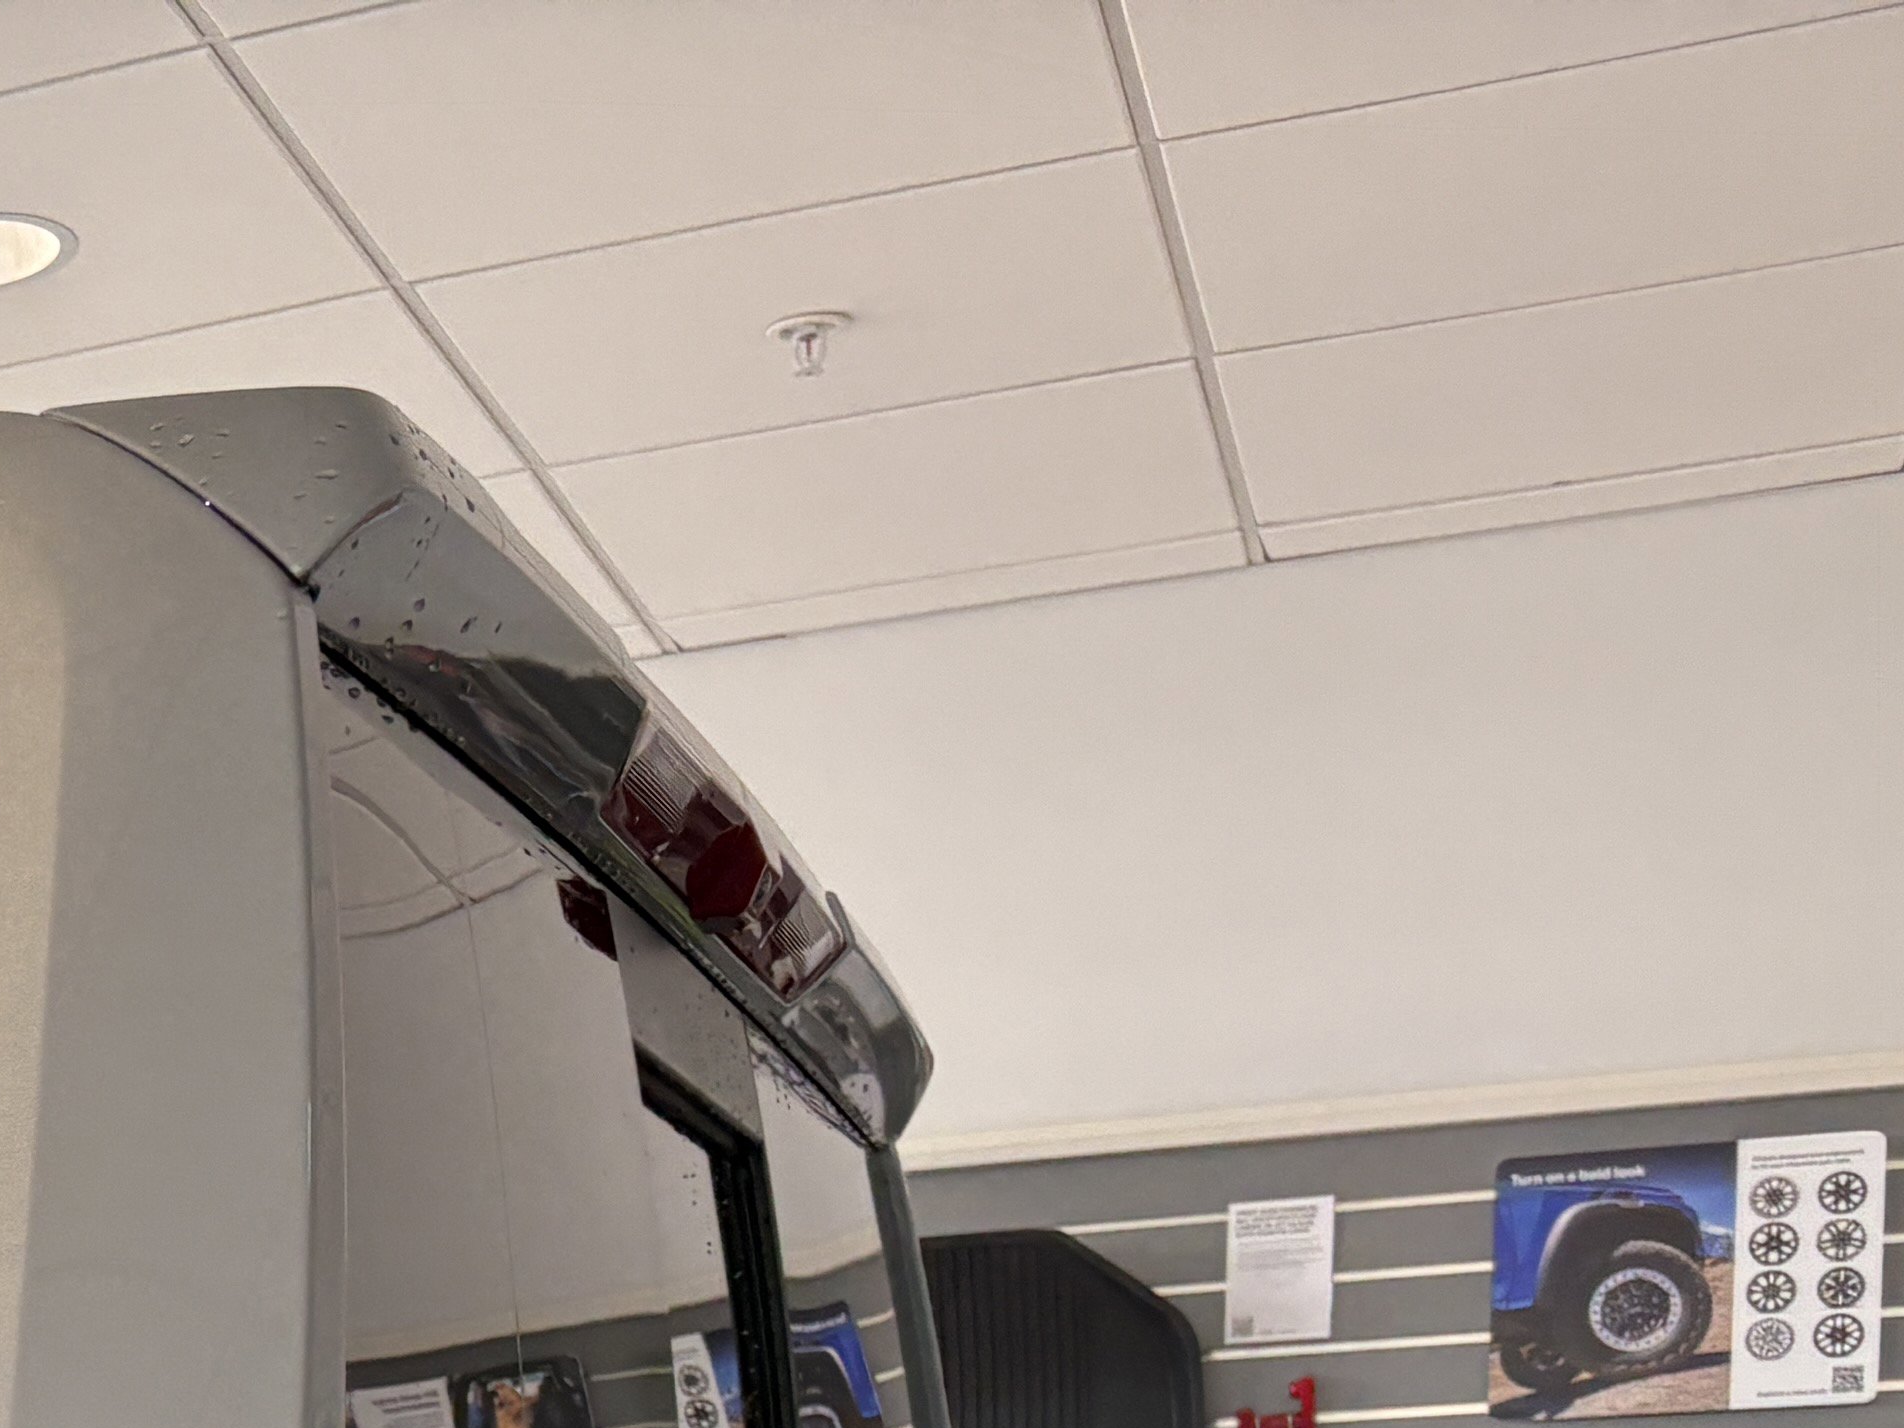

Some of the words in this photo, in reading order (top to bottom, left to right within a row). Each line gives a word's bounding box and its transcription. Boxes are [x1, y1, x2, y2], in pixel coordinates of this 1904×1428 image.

[1511, 1173, 1543, 1187] Turn
[1545, 1172, 1565, 1185] on
[1566, 1172, 1577, 1184] a
